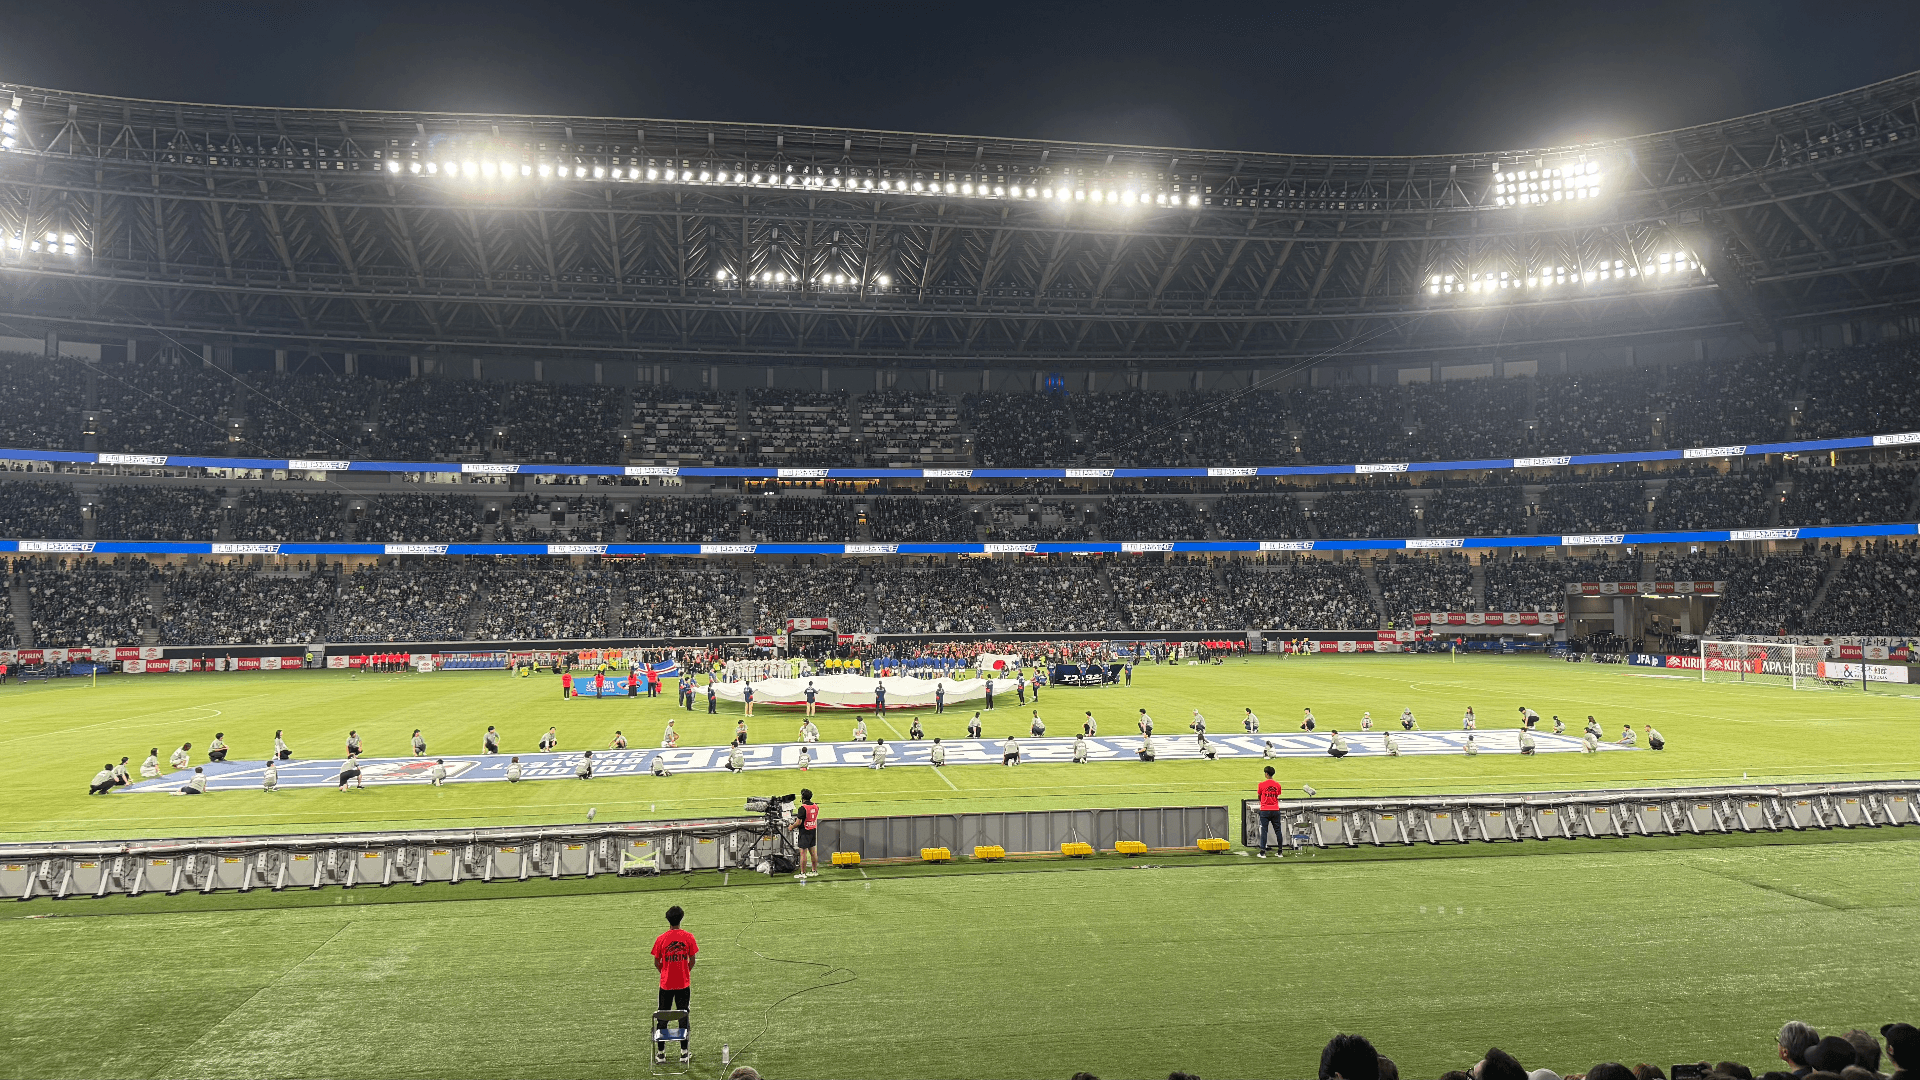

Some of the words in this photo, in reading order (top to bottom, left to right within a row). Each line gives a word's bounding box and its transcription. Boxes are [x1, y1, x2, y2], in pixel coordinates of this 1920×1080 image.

[19, 652, 42, 660] KIRIN
[147, 661, 170, 669] KIRIN
[1762, 662, 1783, 674] APA
